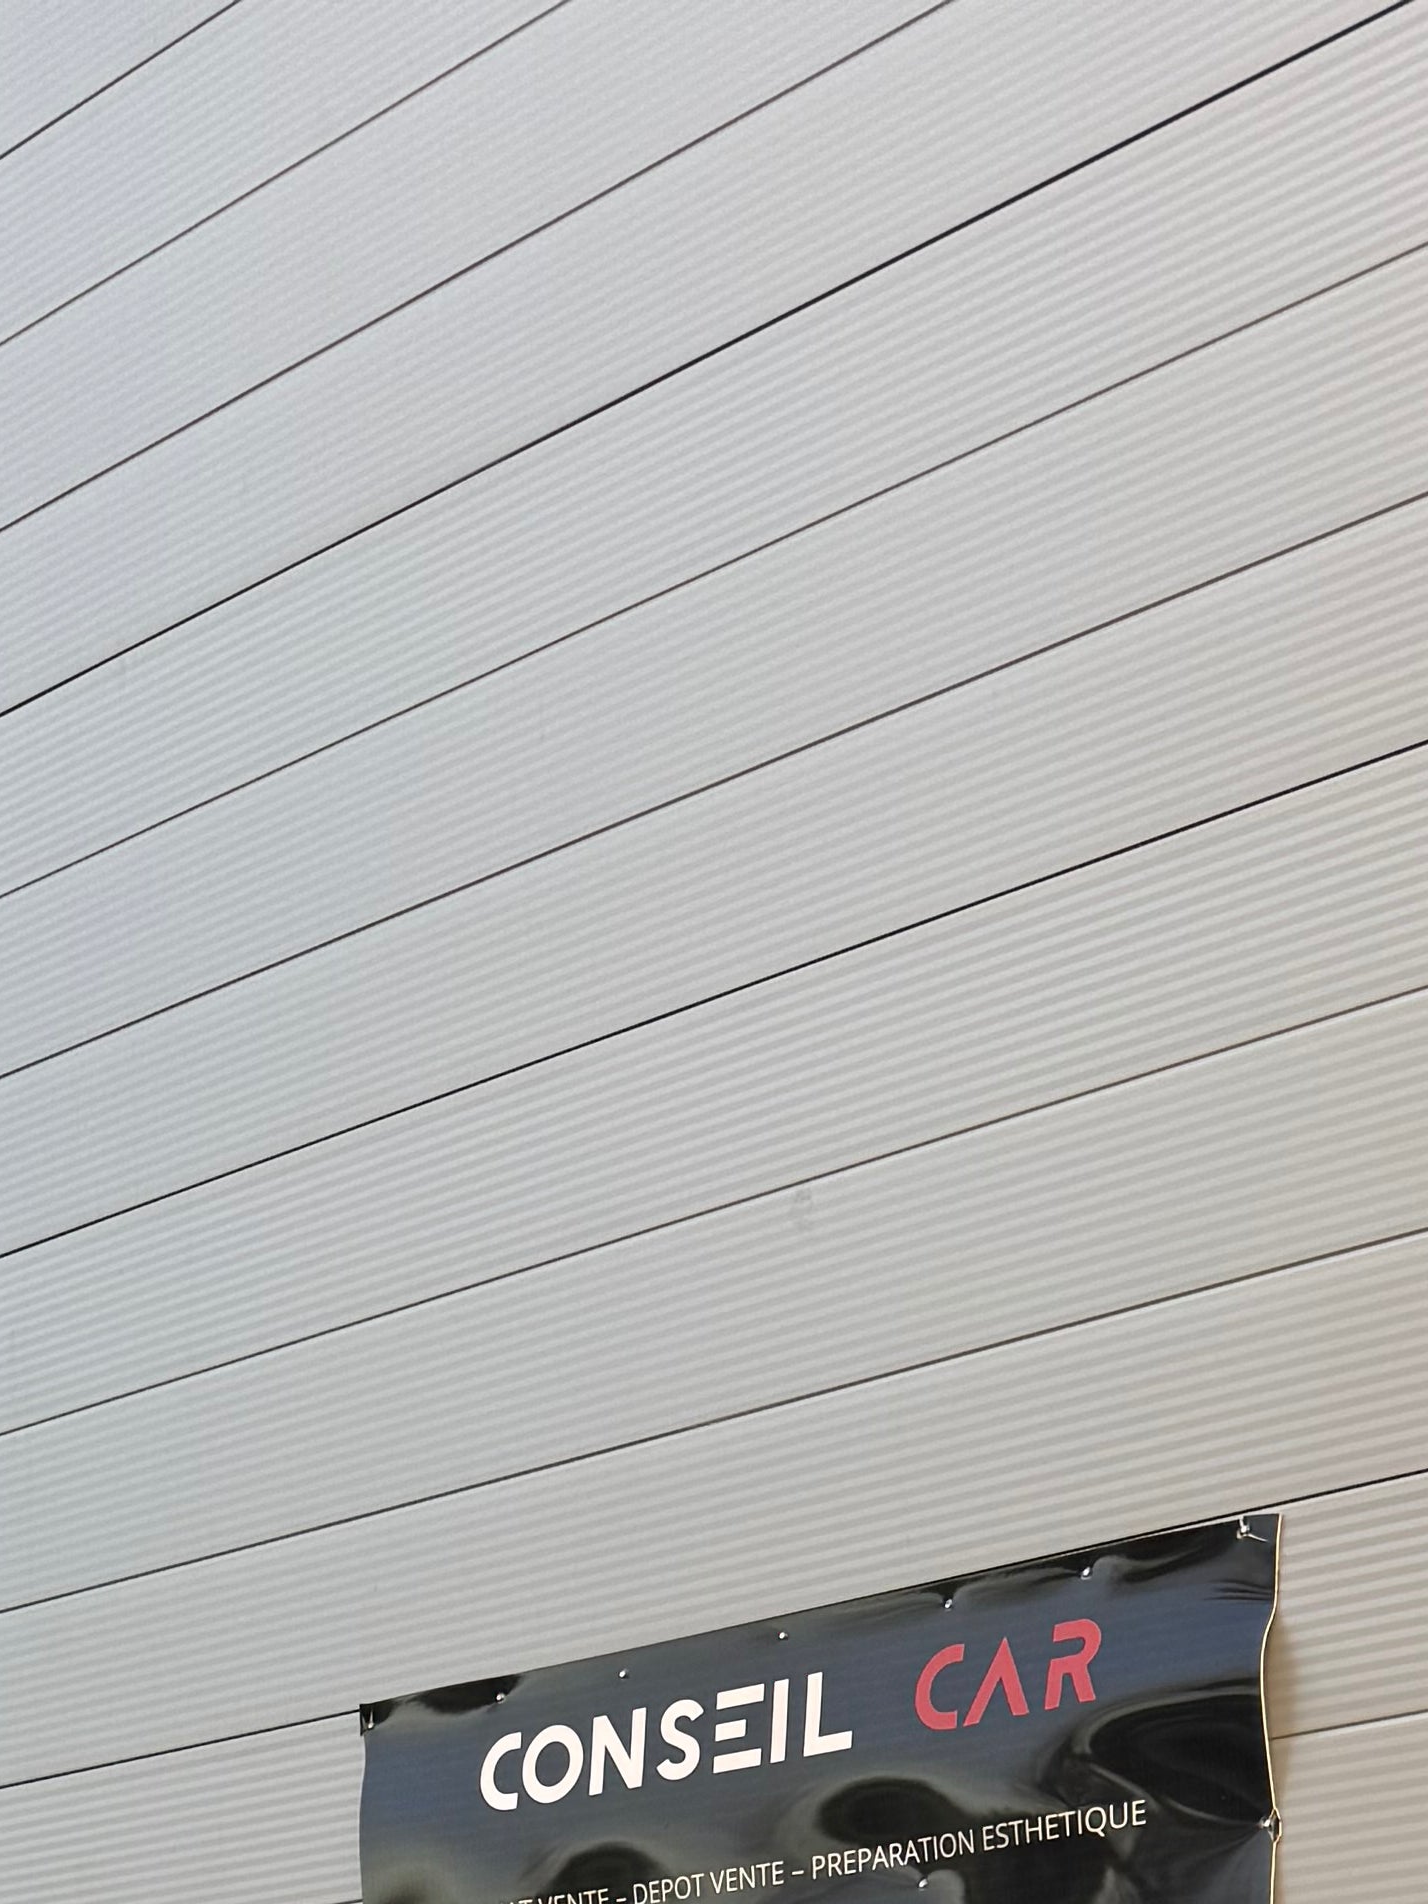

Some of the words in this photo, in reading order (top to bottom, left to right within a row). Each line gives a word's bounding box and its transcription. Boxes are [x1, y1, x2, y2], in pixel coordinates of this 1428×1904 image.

[480, 1671, 853, 1811] CONSEIL
[914, 1618, 1102, 1730] CAR
[709, 1860, 785, 1893] VENTE
[811, 1829, 975, 1880] PREPARATION
[983, 1799, 1147, 1851] ESTHETIQUE
